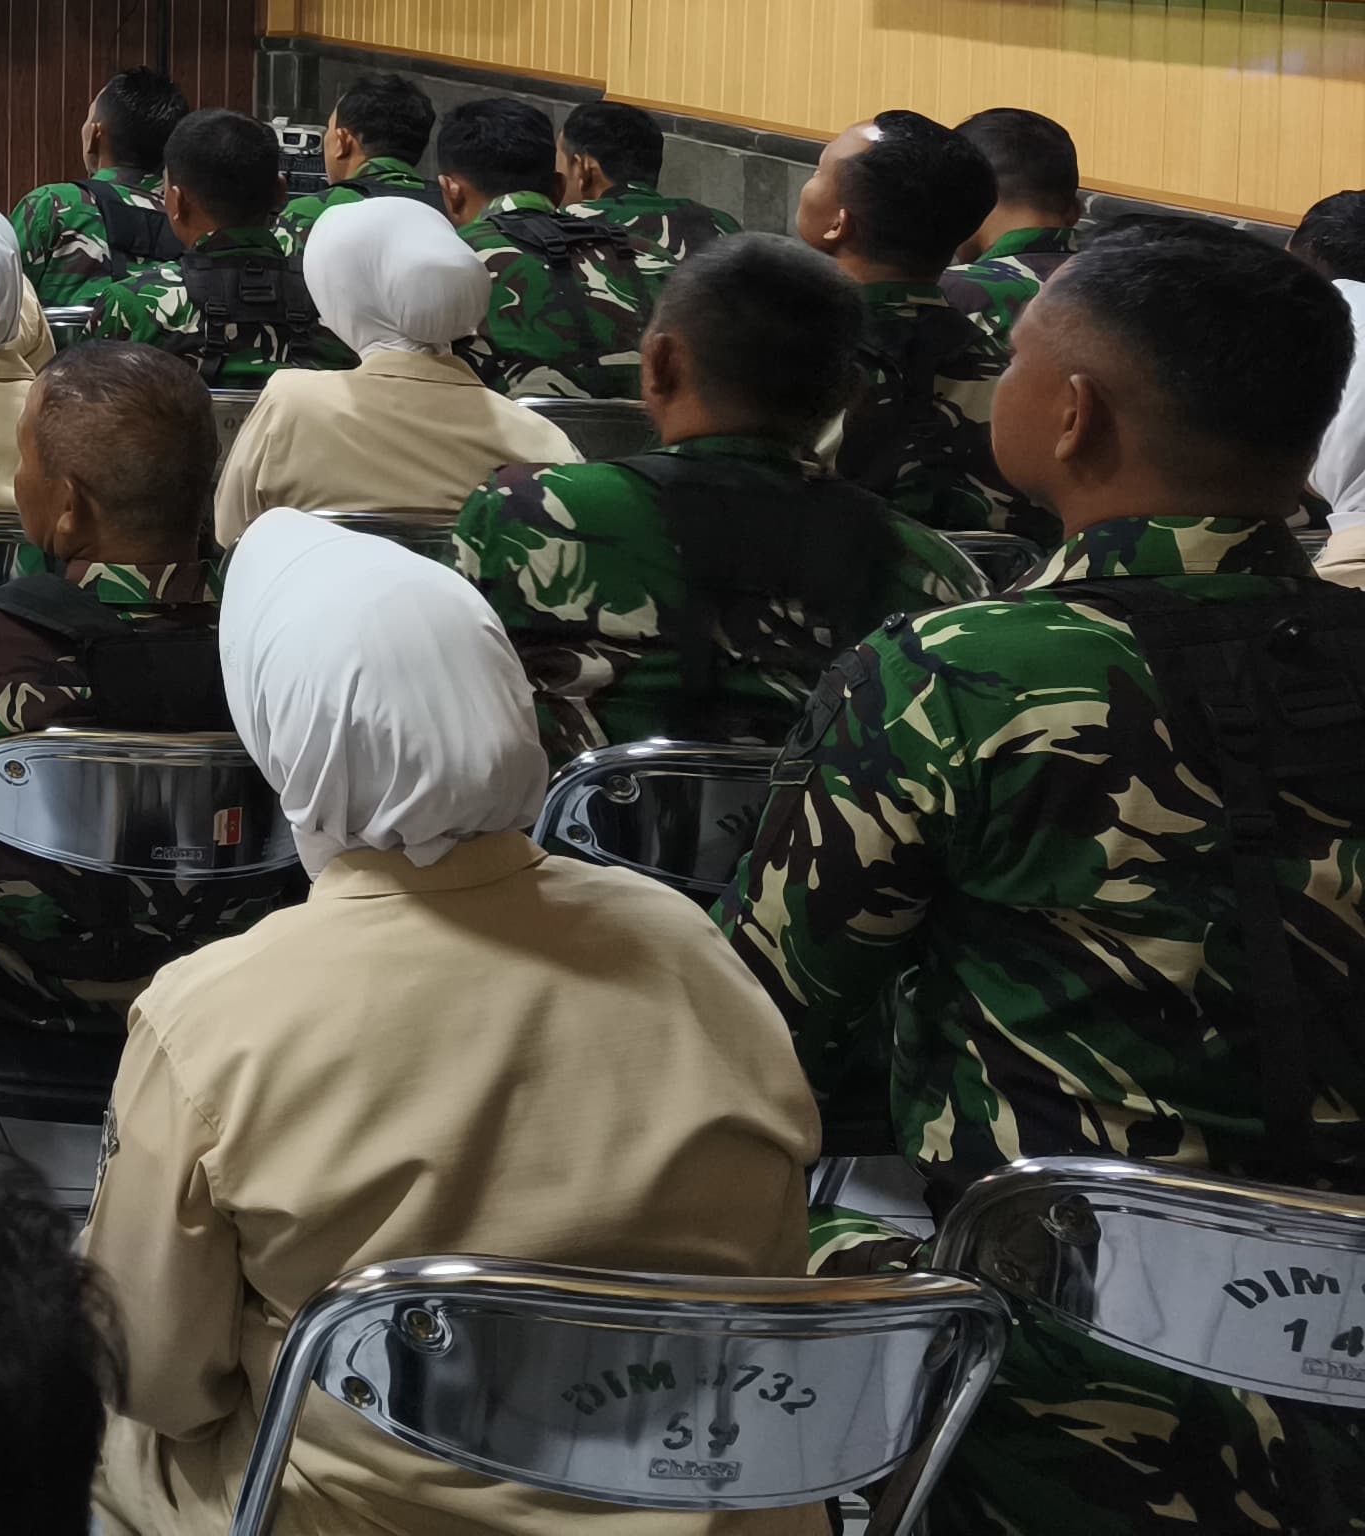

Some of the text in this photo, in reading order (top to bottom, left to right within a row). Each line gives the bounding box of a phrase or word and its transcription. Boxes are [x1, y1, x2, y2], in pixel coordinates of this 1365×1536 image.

[1222, 1266, 1341, 1309] DIM
[1283, 1317, 1365, 1357] 14
[561, 1360, 676, 1415] DIM
